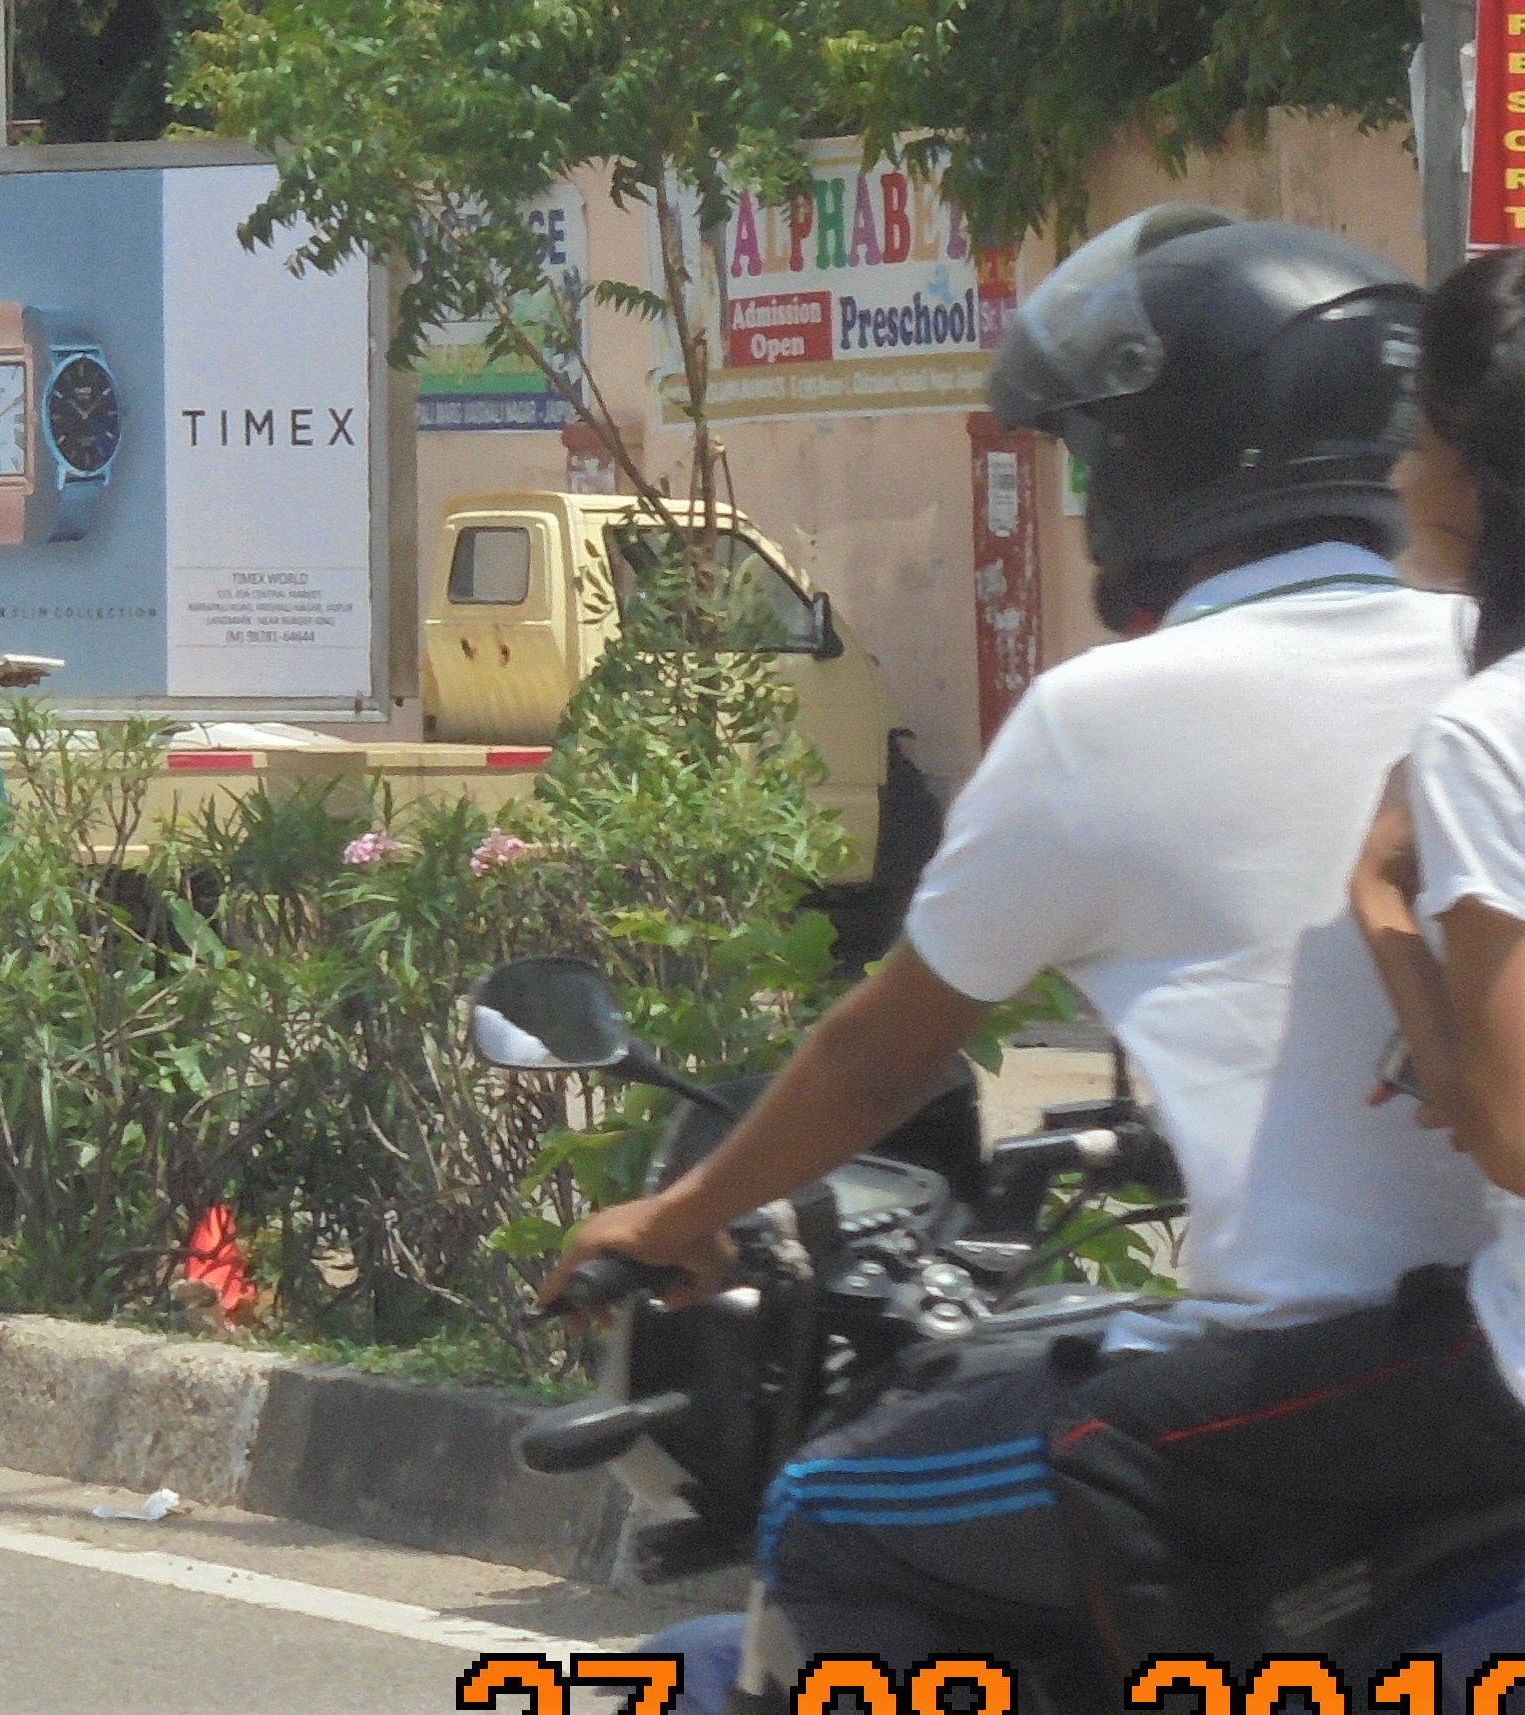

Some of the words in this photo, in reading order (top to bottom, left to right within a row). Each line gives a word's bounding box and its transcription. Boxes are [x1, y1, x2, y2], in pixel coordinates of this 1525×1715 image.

[732, 296, 822, 331] Admission
[839, 287, 977, 350] Preschool
[750, 333, 806, 363] Open
[181, 406, 356, 447] TIMEX
